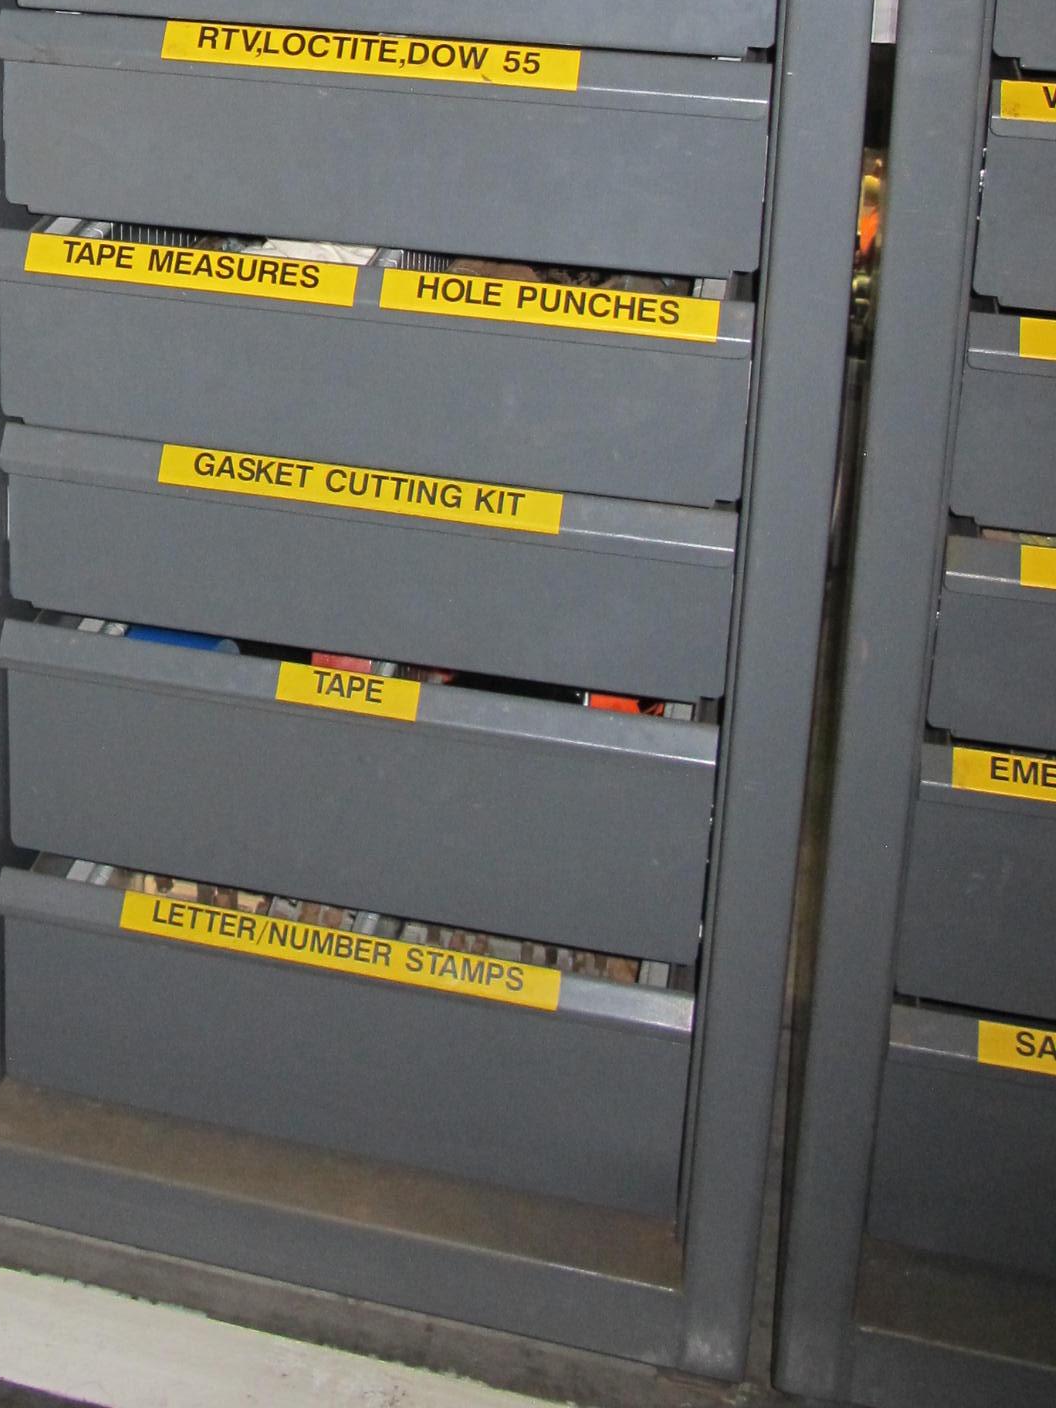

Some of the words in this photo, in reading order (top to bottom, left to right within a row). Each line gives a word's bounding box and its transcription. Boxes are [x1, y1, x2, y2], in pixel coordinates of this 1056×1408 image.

[501, 50, 542, 76] 55
[62, 240, 133, 269] TAPE
[147, 248, 320, 291] MEASURES
[417, 276, 502, 308] HOLE
[517, 286, 682, 327] PUNCHES
[193, 452, 315, 488] GASKET
[325, 468, 463, 510] CUTTING
[475, 485, 527, 517] KIT
[313, 669, 384, 704] TAPE
[151, 899, 393, 968] LETTER/NUMBER
[405, 947, 526, 992] STAMPS
